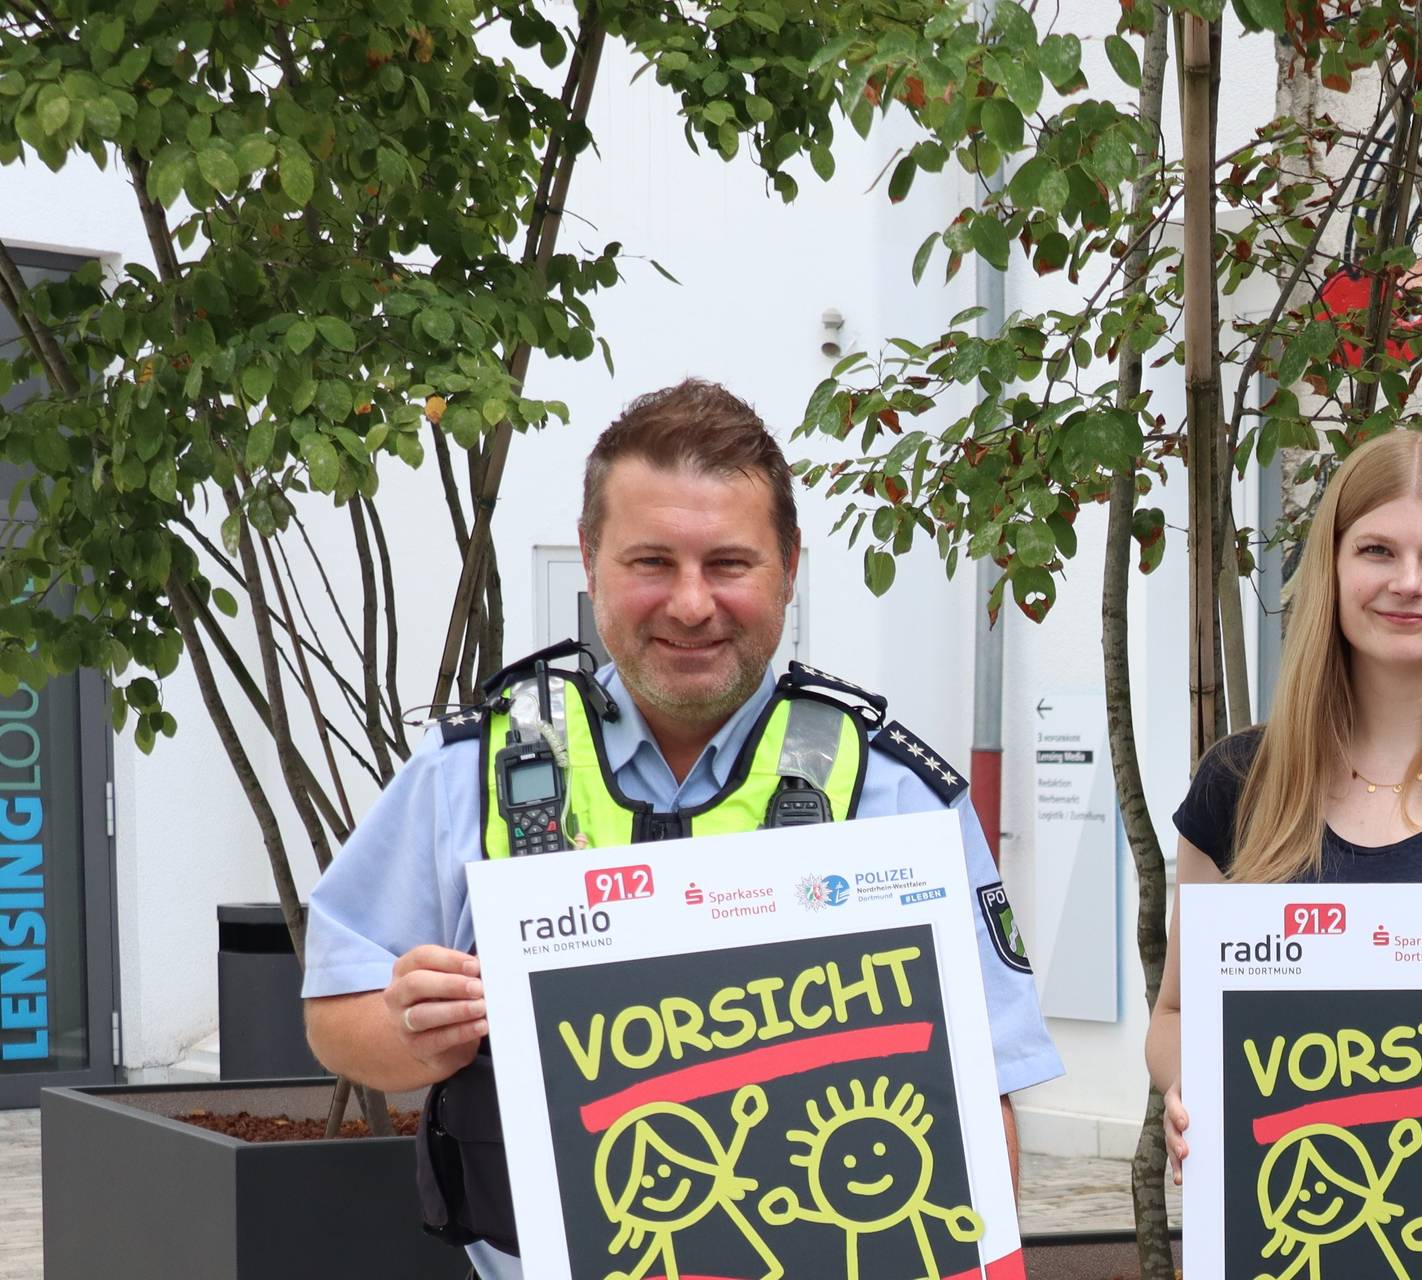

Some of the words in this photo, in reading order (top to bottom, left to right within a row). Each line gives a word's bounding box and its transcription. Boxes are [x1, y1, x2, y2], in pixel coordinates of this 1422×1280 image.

[855, 867, 914, 886] POLIZEI
[708, 886, 774, 904] Sparkasse
[857, 880, 927, 894] Nordrhein-Westfalen
[905, 889, 942, 904] #LEBEN
[519, 904, 611, 942] radio
[596, 870, 651, 902] 91.2
[857, 893, 893, 903] Dortmund
[711, 901, 777, 920] Dortmund
[0, 797, 48, 1060] LENSING
[1220, 934, 1303, 963] radio
[1294, 908, 1342, 934] 91.2
[523, 944, 550, 956] MEIN
[553, 937, 613, 952] DORTMUND
[1220, 967, 1245, 975] MEIN
[1248, 967, 1302, 975] DORTMUND
[558, 947, 921, 1082] VORSICHT
